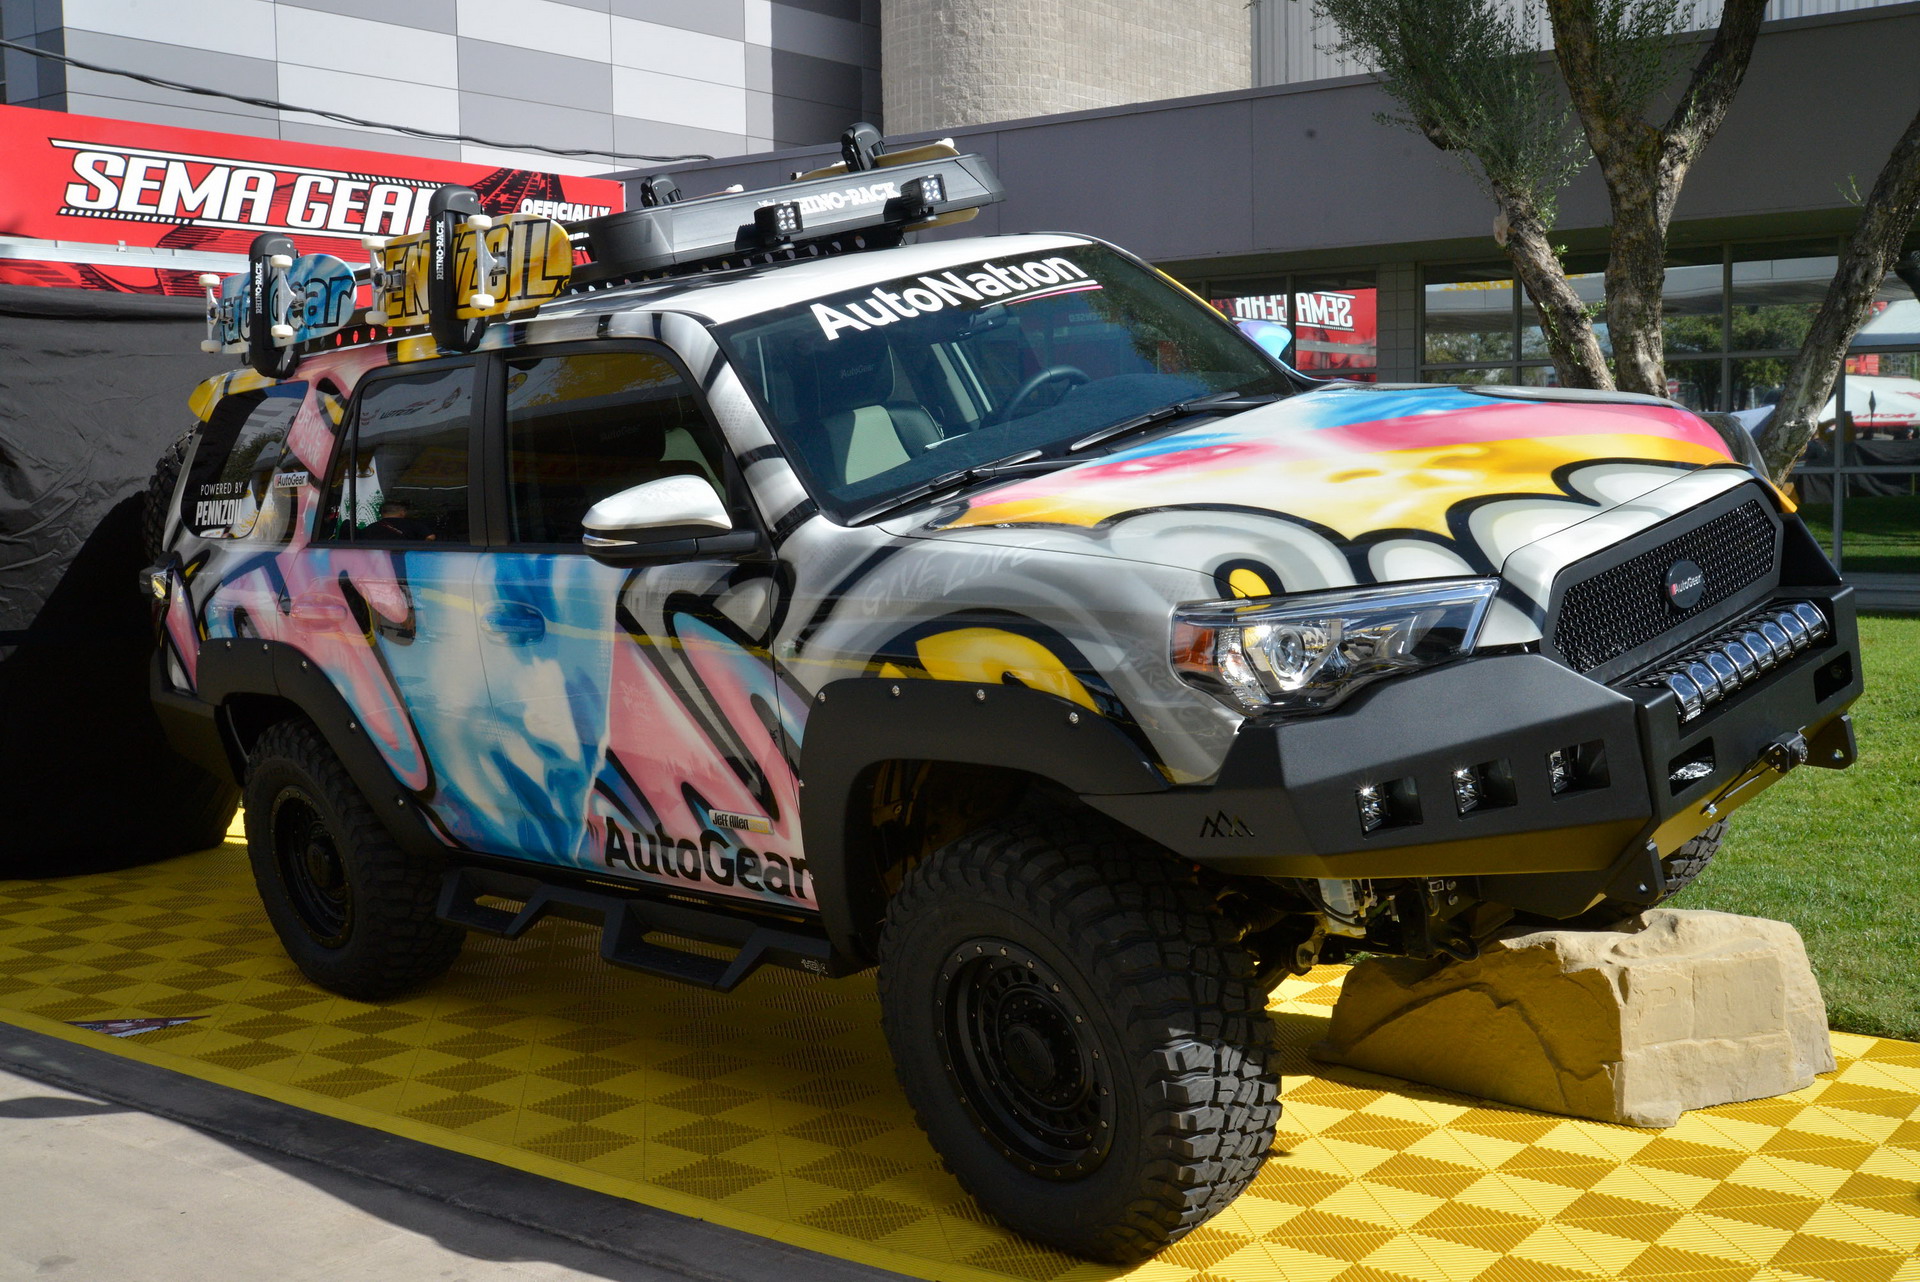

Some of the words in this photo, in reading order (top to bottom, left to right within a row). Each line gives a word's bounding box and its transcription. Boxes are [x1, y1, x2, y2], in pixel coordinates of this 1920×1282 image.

[65, 149, 277, 224] SEMA
[784, 182, 902, 215] HINO-RACK
[521, 198, 611, 222] OFFICIALLY
[436, 220, 444, 280] RHINO-RACK
[810, 256, 1088, 341] AutoNation
[200, 483, 231, 496] POWERED
[234, 481, 243, 494] BY
[277, 473, 305, 487] AutoGear
[195, 498, 243, 526] PENNZOIL
[862, 551, 939, 616] GIVE
[1675, 574, 1701, 593] AutoGear
[713, 812, 728, 827] Jeff
[605, 816, 809, 899] AutoGear
